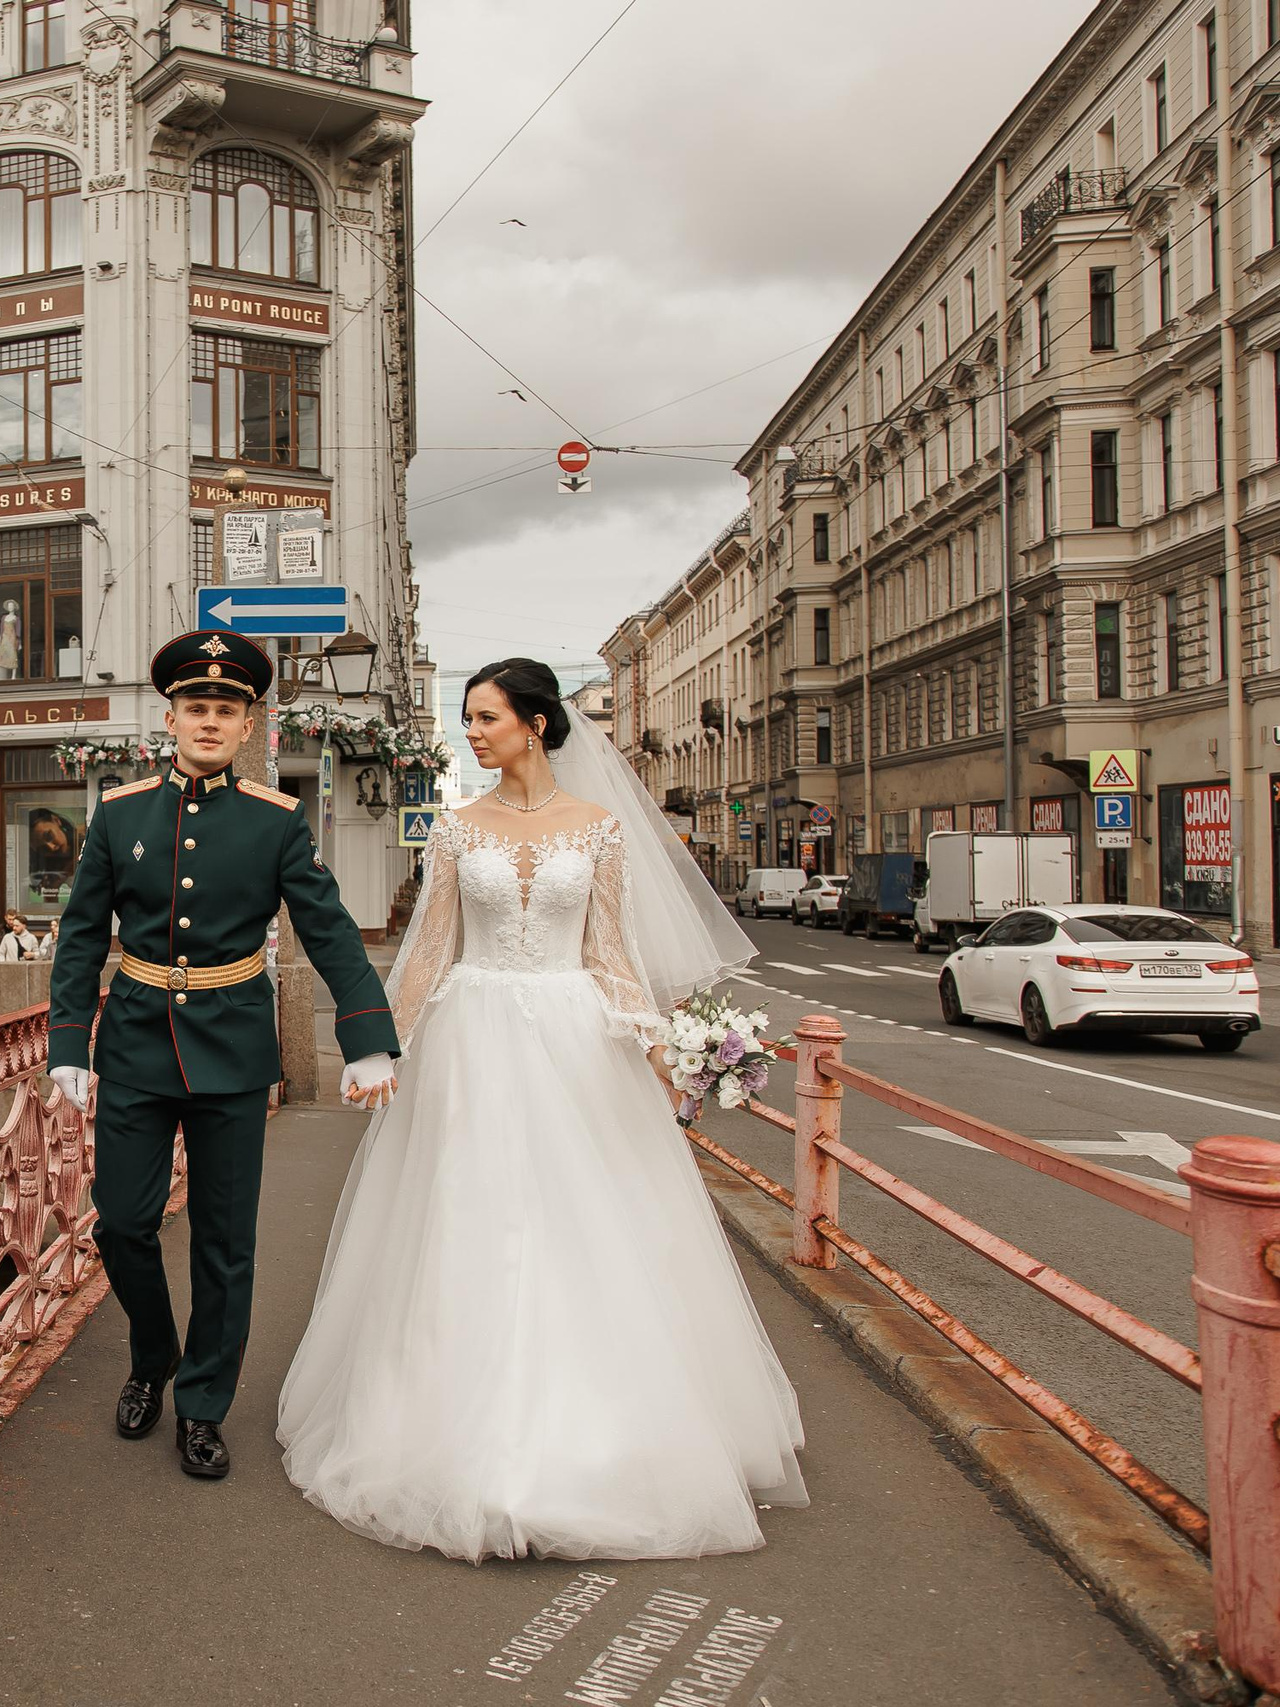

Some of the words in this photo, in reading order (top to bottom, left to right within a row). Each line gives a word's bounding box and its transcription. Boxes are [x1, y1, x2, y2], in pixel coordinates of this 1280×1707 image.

[193, 293, 214, 308] AU
[220, 297, 262, 315] PONT
[270, 304, 324, 325] ROUGE
[284, 494, 328, 511] МОСТА
[1033, 802, 1062, 831] СДАНО
[1103, 798, 1124, 824] P
[1185, 789, 1230, 825] СДАНО
[1185, 829, 1231, 861] 939-38-55
[644, 1588, 712, 1620] ПО
[563, 1613, 690, 1707] КРЫШАМ
